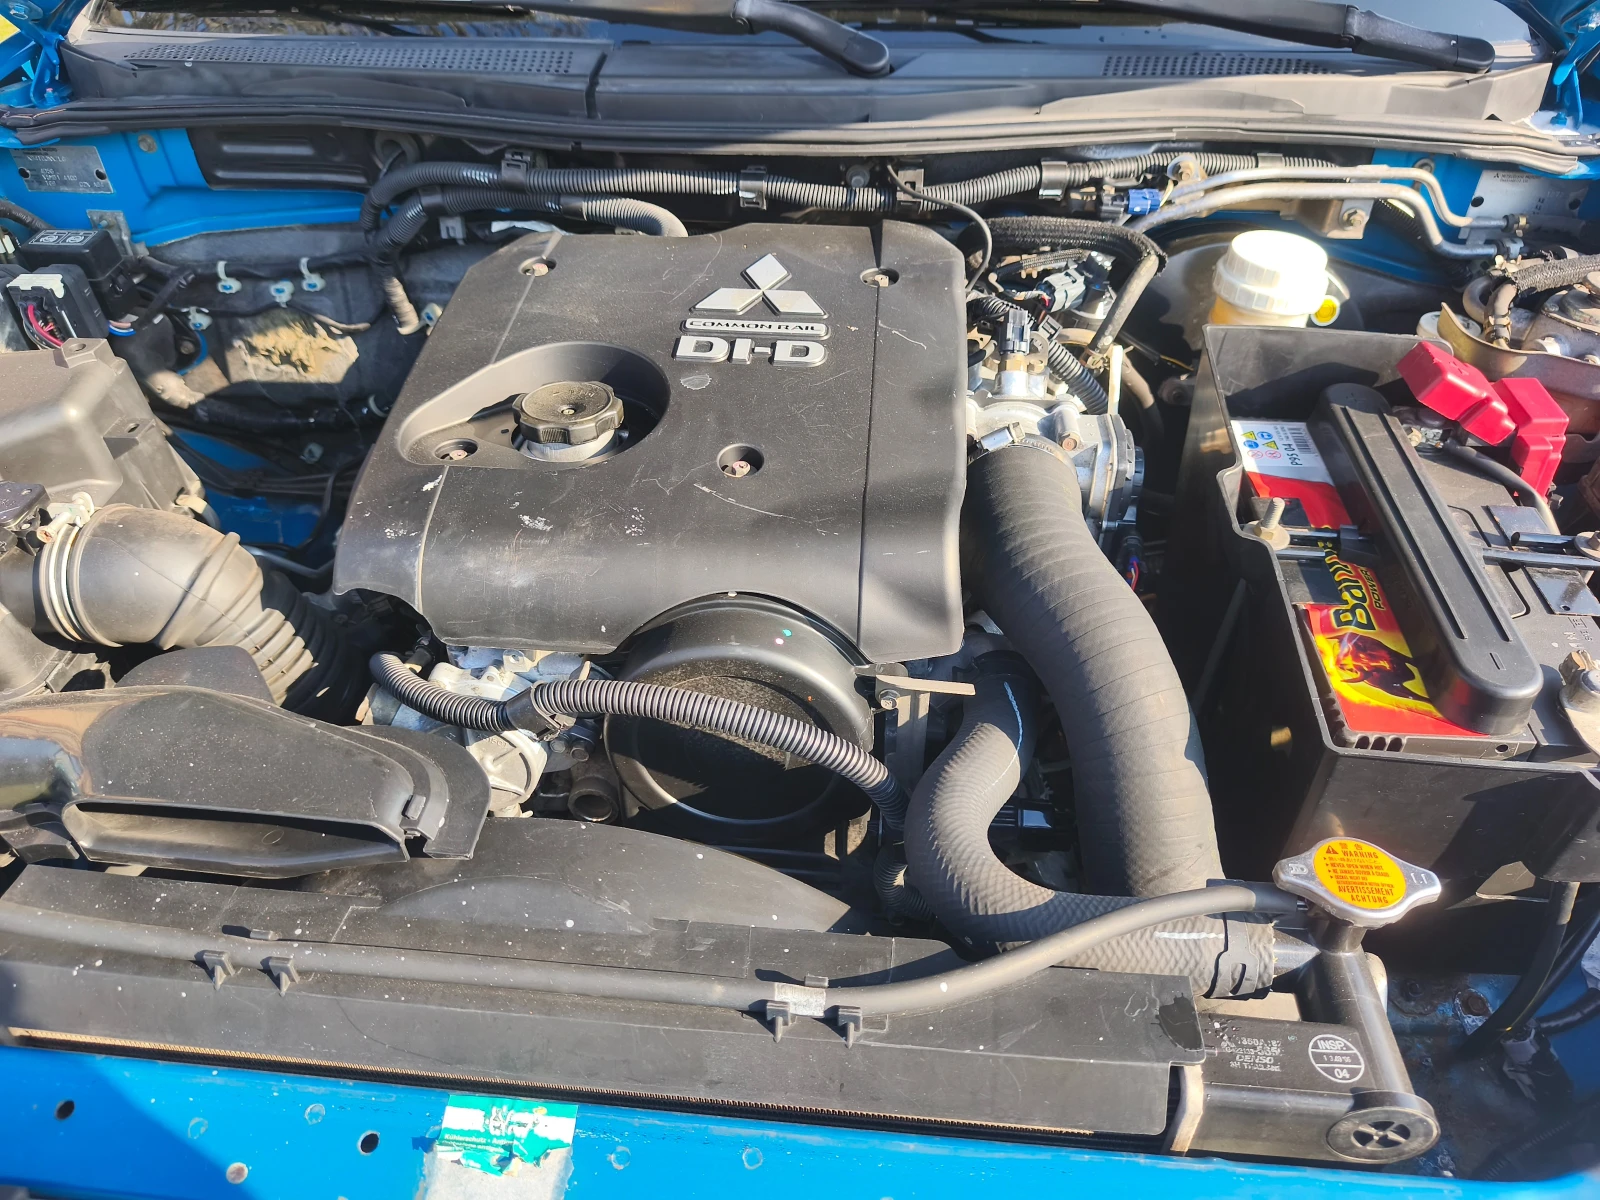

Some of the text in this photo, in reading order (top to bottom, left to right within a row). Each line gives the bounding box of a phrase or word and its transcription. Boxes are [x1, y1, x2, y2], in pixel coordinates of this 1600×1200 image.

[689, 320, 822, 331] COMMON RAIL
[674, 335, 827, 367] DI-D
[1282, 443, 1296, 452] 04
[1287, 453, 1303, 466] P95
[1316, 538, 1377, 631] Banne
[1360, 568, 1386, 611] POWER
[1341, 850, 1379, 859] WARNING
[1410, 872, 1428, 885] 1.1
[1338, 885, 1394, 896] AVERTISSEMENT
[1350, 895, 1389, 904] ACHTUNG
[1317, 1040, 1346, 1050] INSP.
[1236, 1055, 1274, 1064] DENSO
[1334, 1068, 1350, 1079] 04
